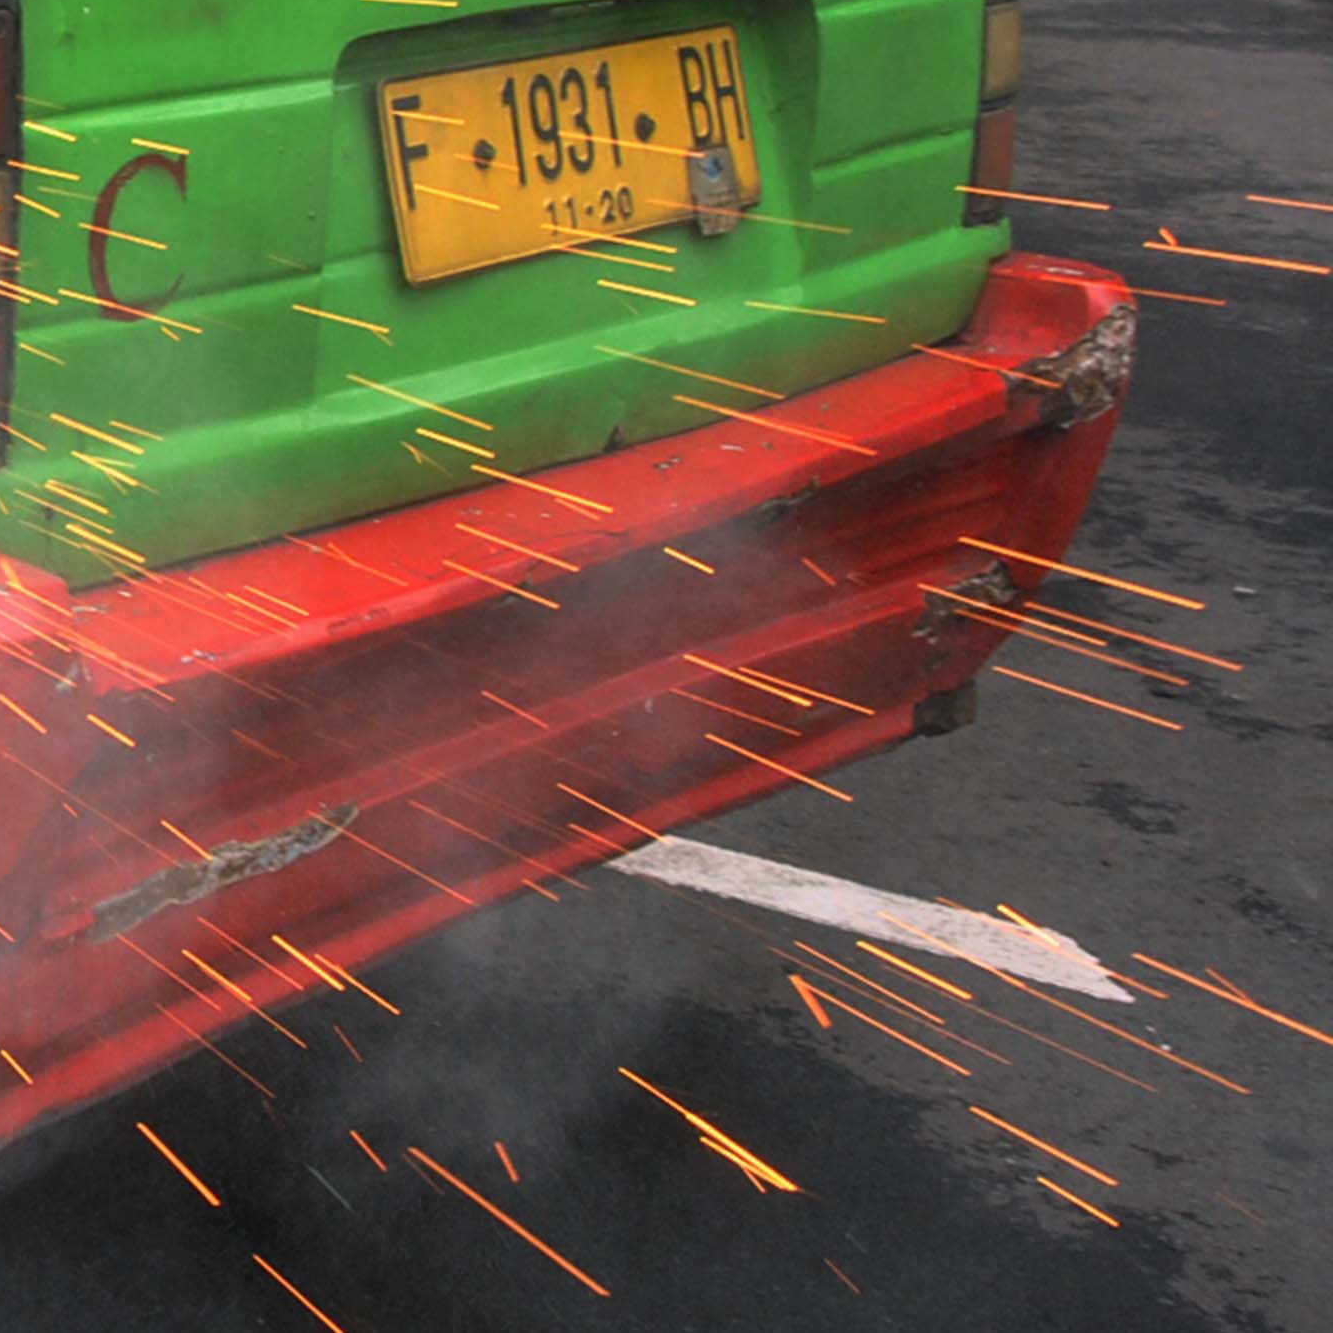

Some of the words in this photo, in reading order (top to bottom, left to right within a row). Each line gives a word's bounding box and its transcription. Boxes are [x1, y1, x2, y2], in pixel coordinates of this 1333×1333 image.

[391, 93, 429, 212] F
[500, 60, 623, 187] 1931
[677, 38, 746, 146] BH
